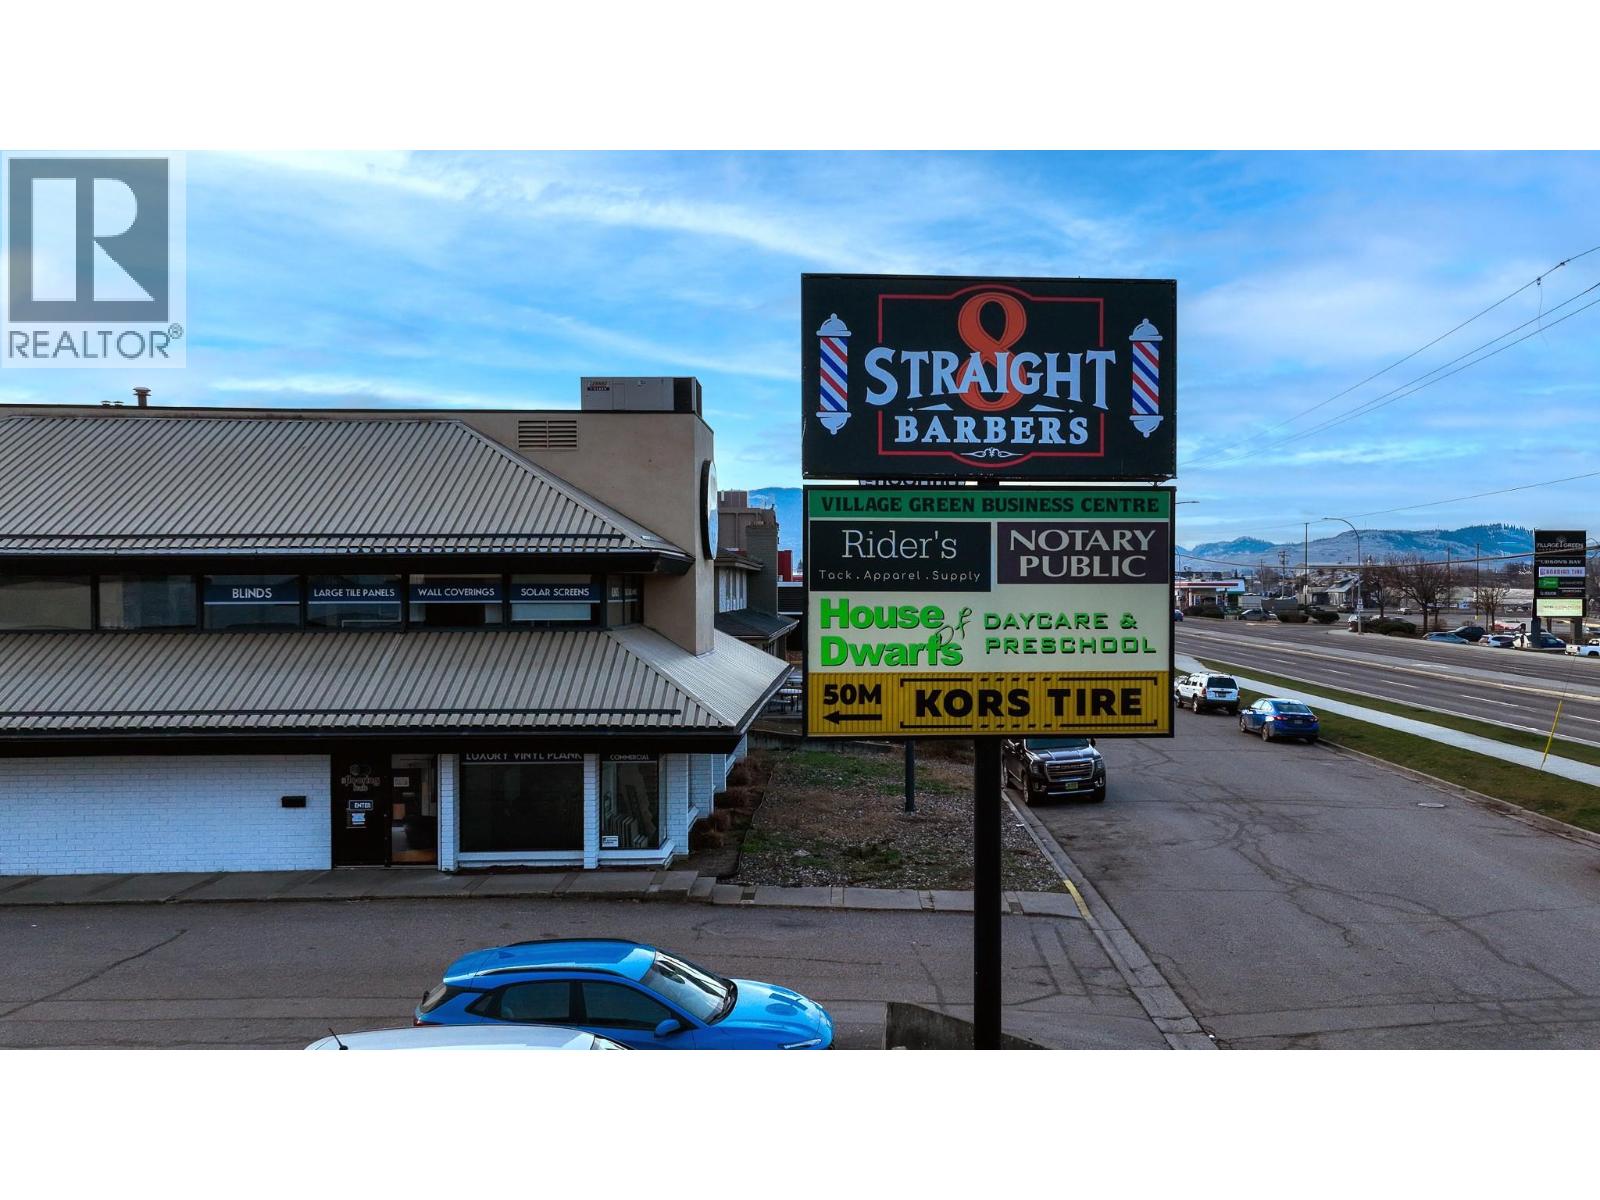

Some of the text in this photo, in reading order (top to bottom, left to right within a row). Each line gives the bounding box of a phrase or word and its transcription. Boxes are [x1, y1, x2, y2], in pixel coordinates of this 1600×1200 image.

[955, 291, 1027, 412] 8
[864, 346, 1117, 411] STRAIGHT
[894, 416, 1089, 445] BARBERS
[820, 495, 1159, 513] VILLAGE GREEN BUSINESS CENTRE
[841, 529, 958, 559] Rider's
[1009, 529, 1156, 552] NOTARY
[932, 569, 981, 582] Supply
[1019, 555, 1147, 578] PUBLIC
[232, 587, 273, 600] BLINDS
[313, 588, 395, 599] LARGE TILE PANELS
[418, 587, 495, 598] WALL COVERINGS
[520, 587, 590, 598] SOLAR SCREENS
[820, 598, 945, 630] House
[984, 612, 1138, 631] DAYCARE &
[820, 636, 964, 667] Dwarfs
[985, 636, 1157, 655] PRESCHOOL
[823, 683, 882, 706] 50M
[915, 687, 1143, 718] KORS TIRE
